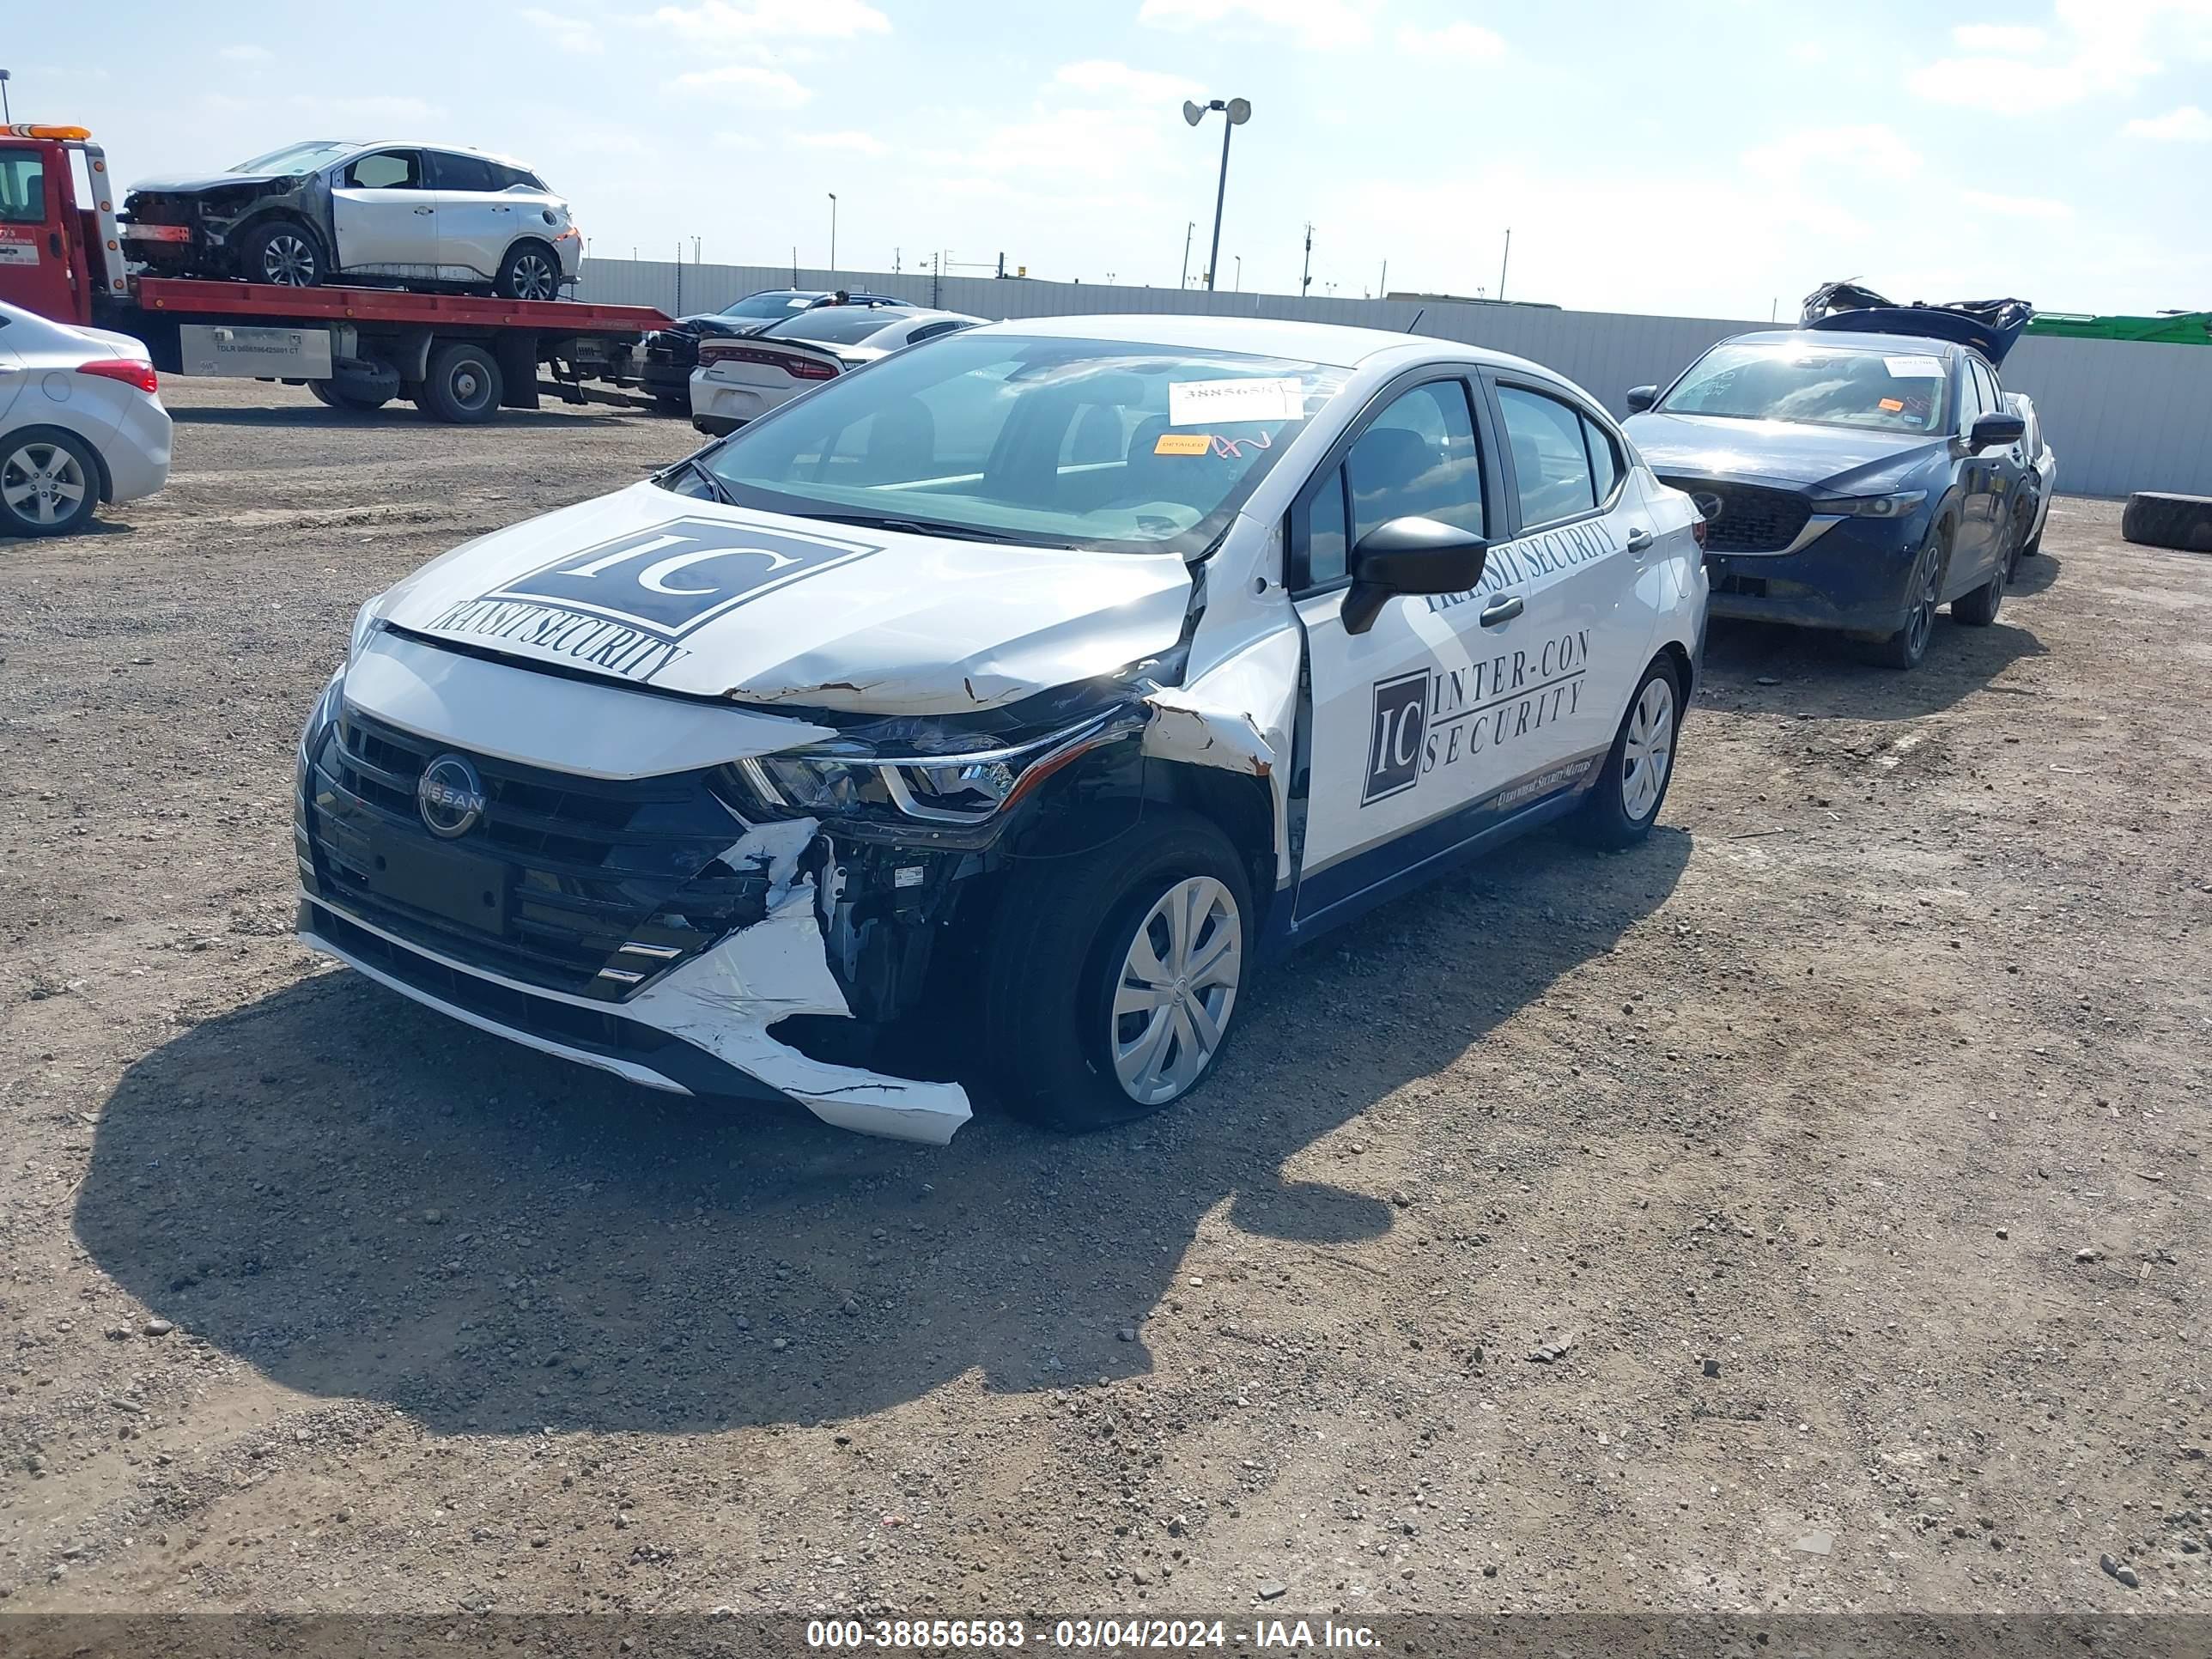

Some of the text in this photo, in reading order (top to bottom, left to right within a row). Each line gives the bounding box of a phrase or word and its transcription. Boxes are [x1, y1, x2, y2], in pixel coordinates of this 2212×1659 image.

[556, 534, 803, 595] IC
[1518, 520, 1618, 578] SECURITY
[422, 601, 692, 684] TRANSIT SECURITY
[1430, 629, 1591, 716] INTER-CON
[1374, 698, 1423, 775] IC
[1421, 679, 1585, 775] SECURITY
[418, 775, 483, 811] NISSAN
